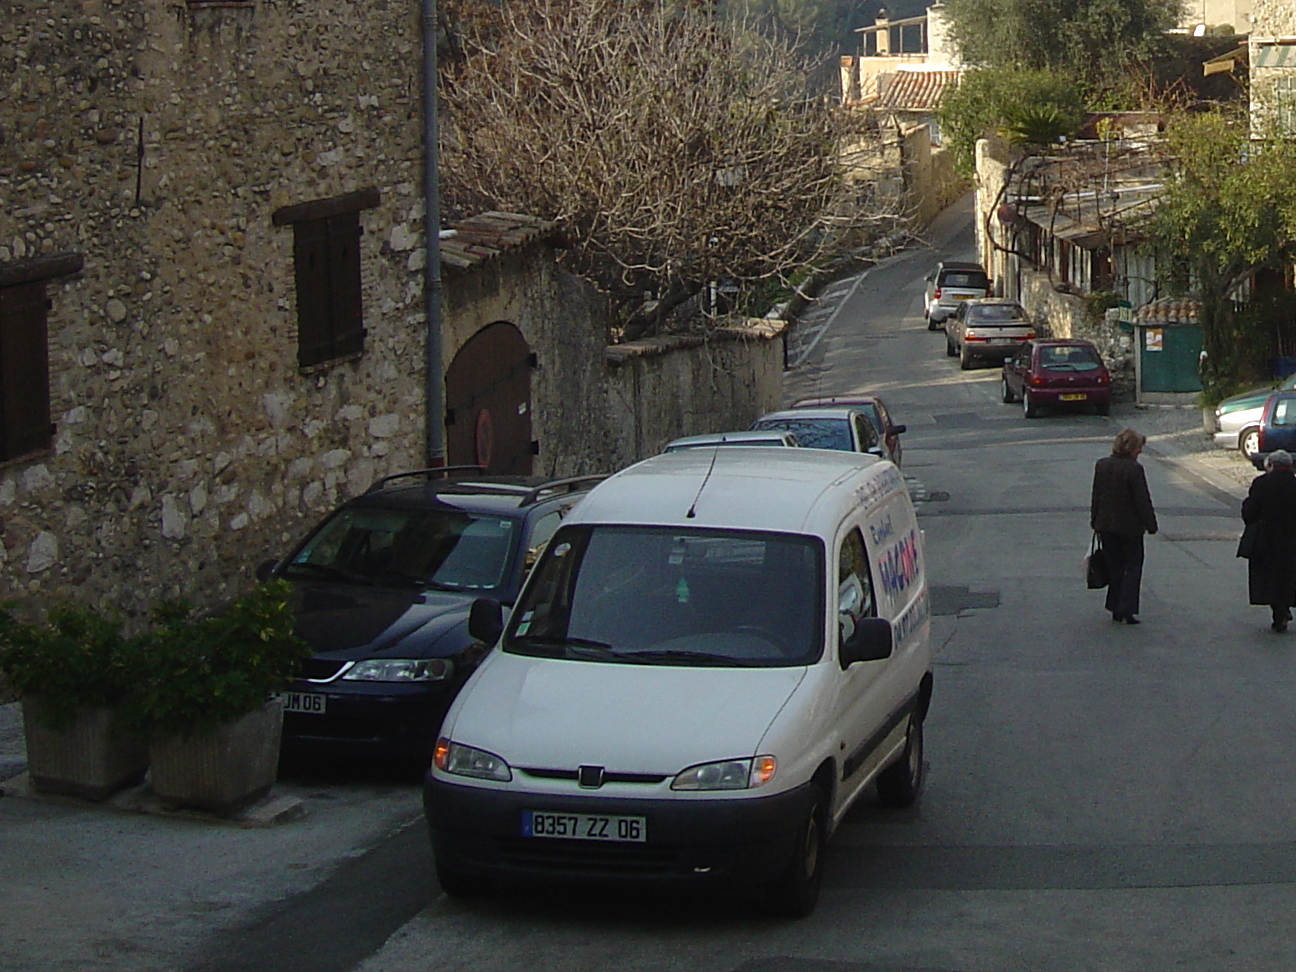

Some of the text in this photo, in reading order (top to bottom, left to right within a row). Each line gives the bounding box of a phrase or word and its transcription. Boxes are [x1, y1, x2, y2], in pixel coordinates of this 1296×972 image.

[303, 695, 321, 711] 06
[534, 814, 640, 839] 8357 ZZ 06
